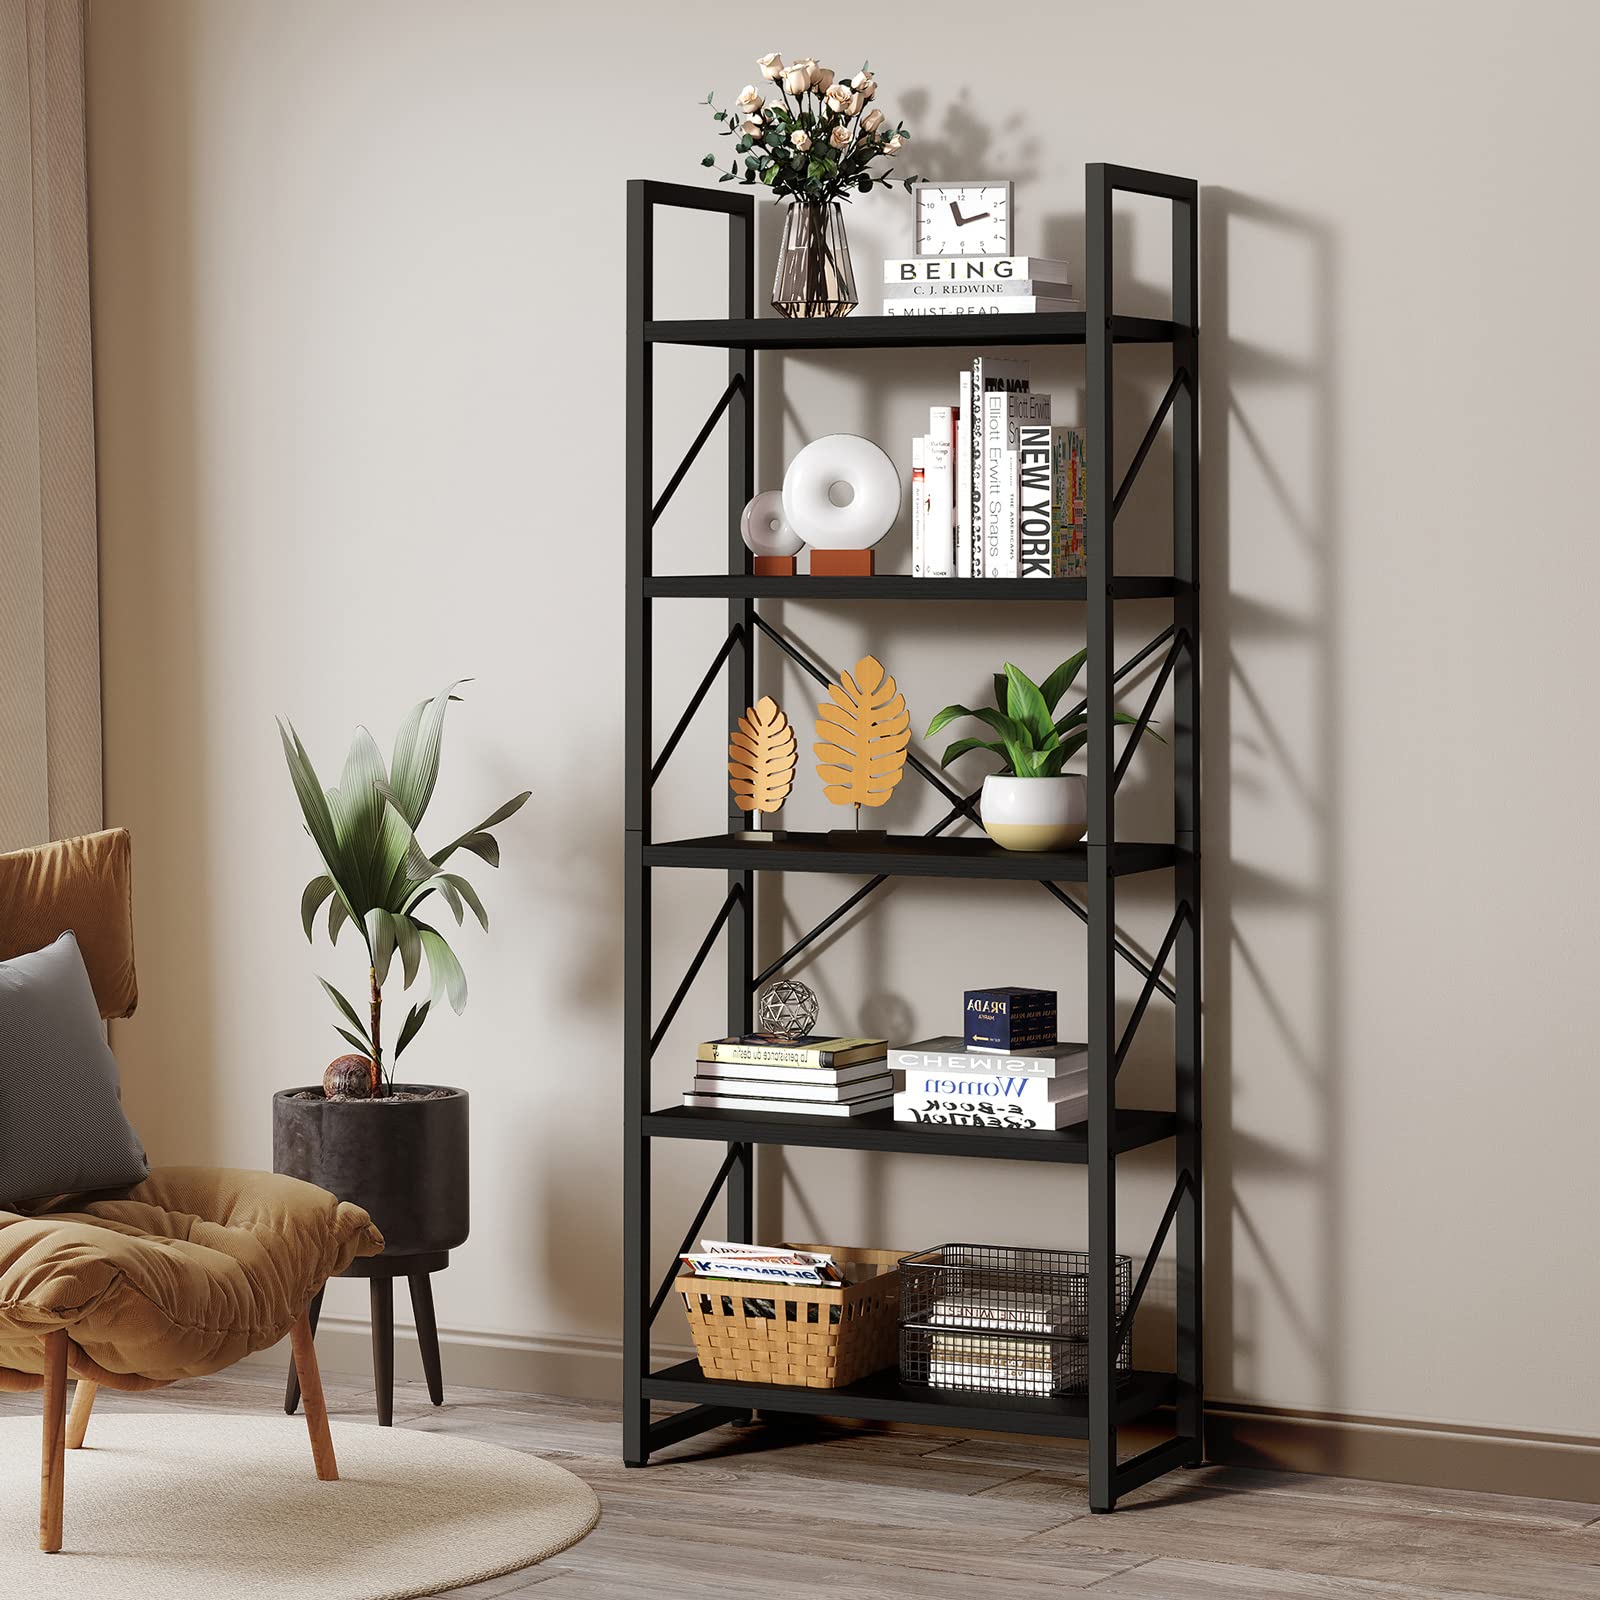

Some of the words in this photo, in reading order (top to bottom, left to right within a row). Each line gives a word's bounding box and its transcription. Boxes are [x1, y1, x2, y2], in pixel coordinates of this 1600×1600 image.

[939, 194, 947, 202] 11
[957, 194, 966, 202] 12
[900, 260, 1013, 280] BEING
[913, 285, 925, 295] C.
[929, 285, 937, 295] J.
[942, 284, 1003, 294] REDWINE
[989, 396, 1002, 441] Elliott
[989, 447, 1002, 494] Erwitt
[1021, 428, 1050, 491] NEW
[987, 500, 1002, 557] Snaps
[1020, 499, 1051, 577] YORK
